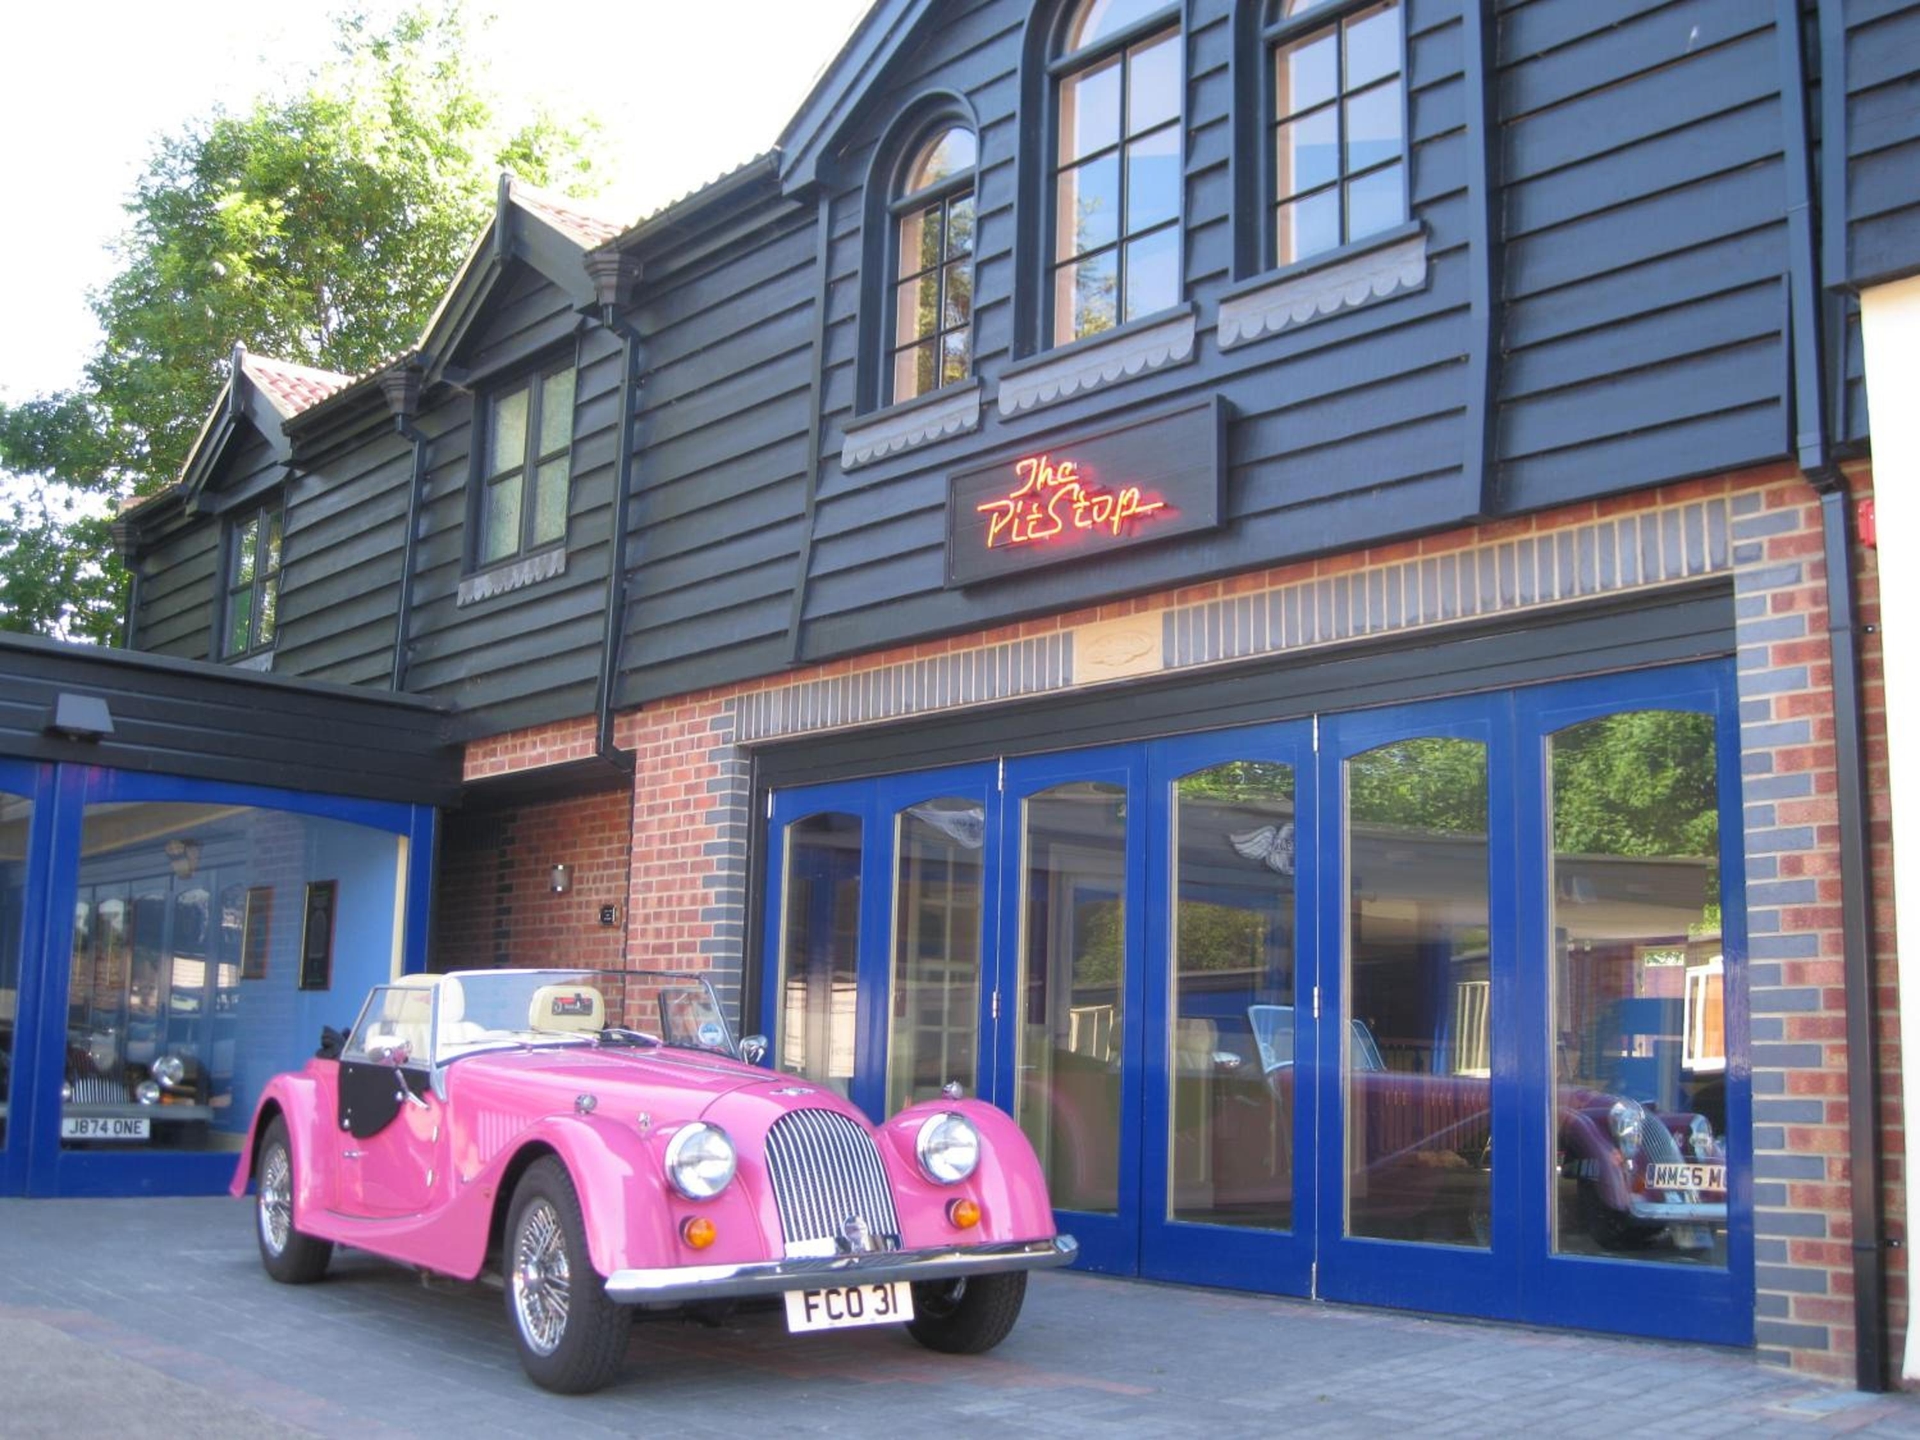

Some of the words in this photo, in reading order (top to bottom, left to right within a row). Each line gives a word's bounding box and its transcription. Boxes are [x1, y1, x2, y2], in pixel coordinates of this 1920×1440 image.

[1010, 456, 1079, 498] The
[113, 1121, 143, 1135] ONE
[1709, 1167, 1727, 1188] M
[804, 1287, 864, 1323] FCO
[872, 1282, 898, 1316] 31
